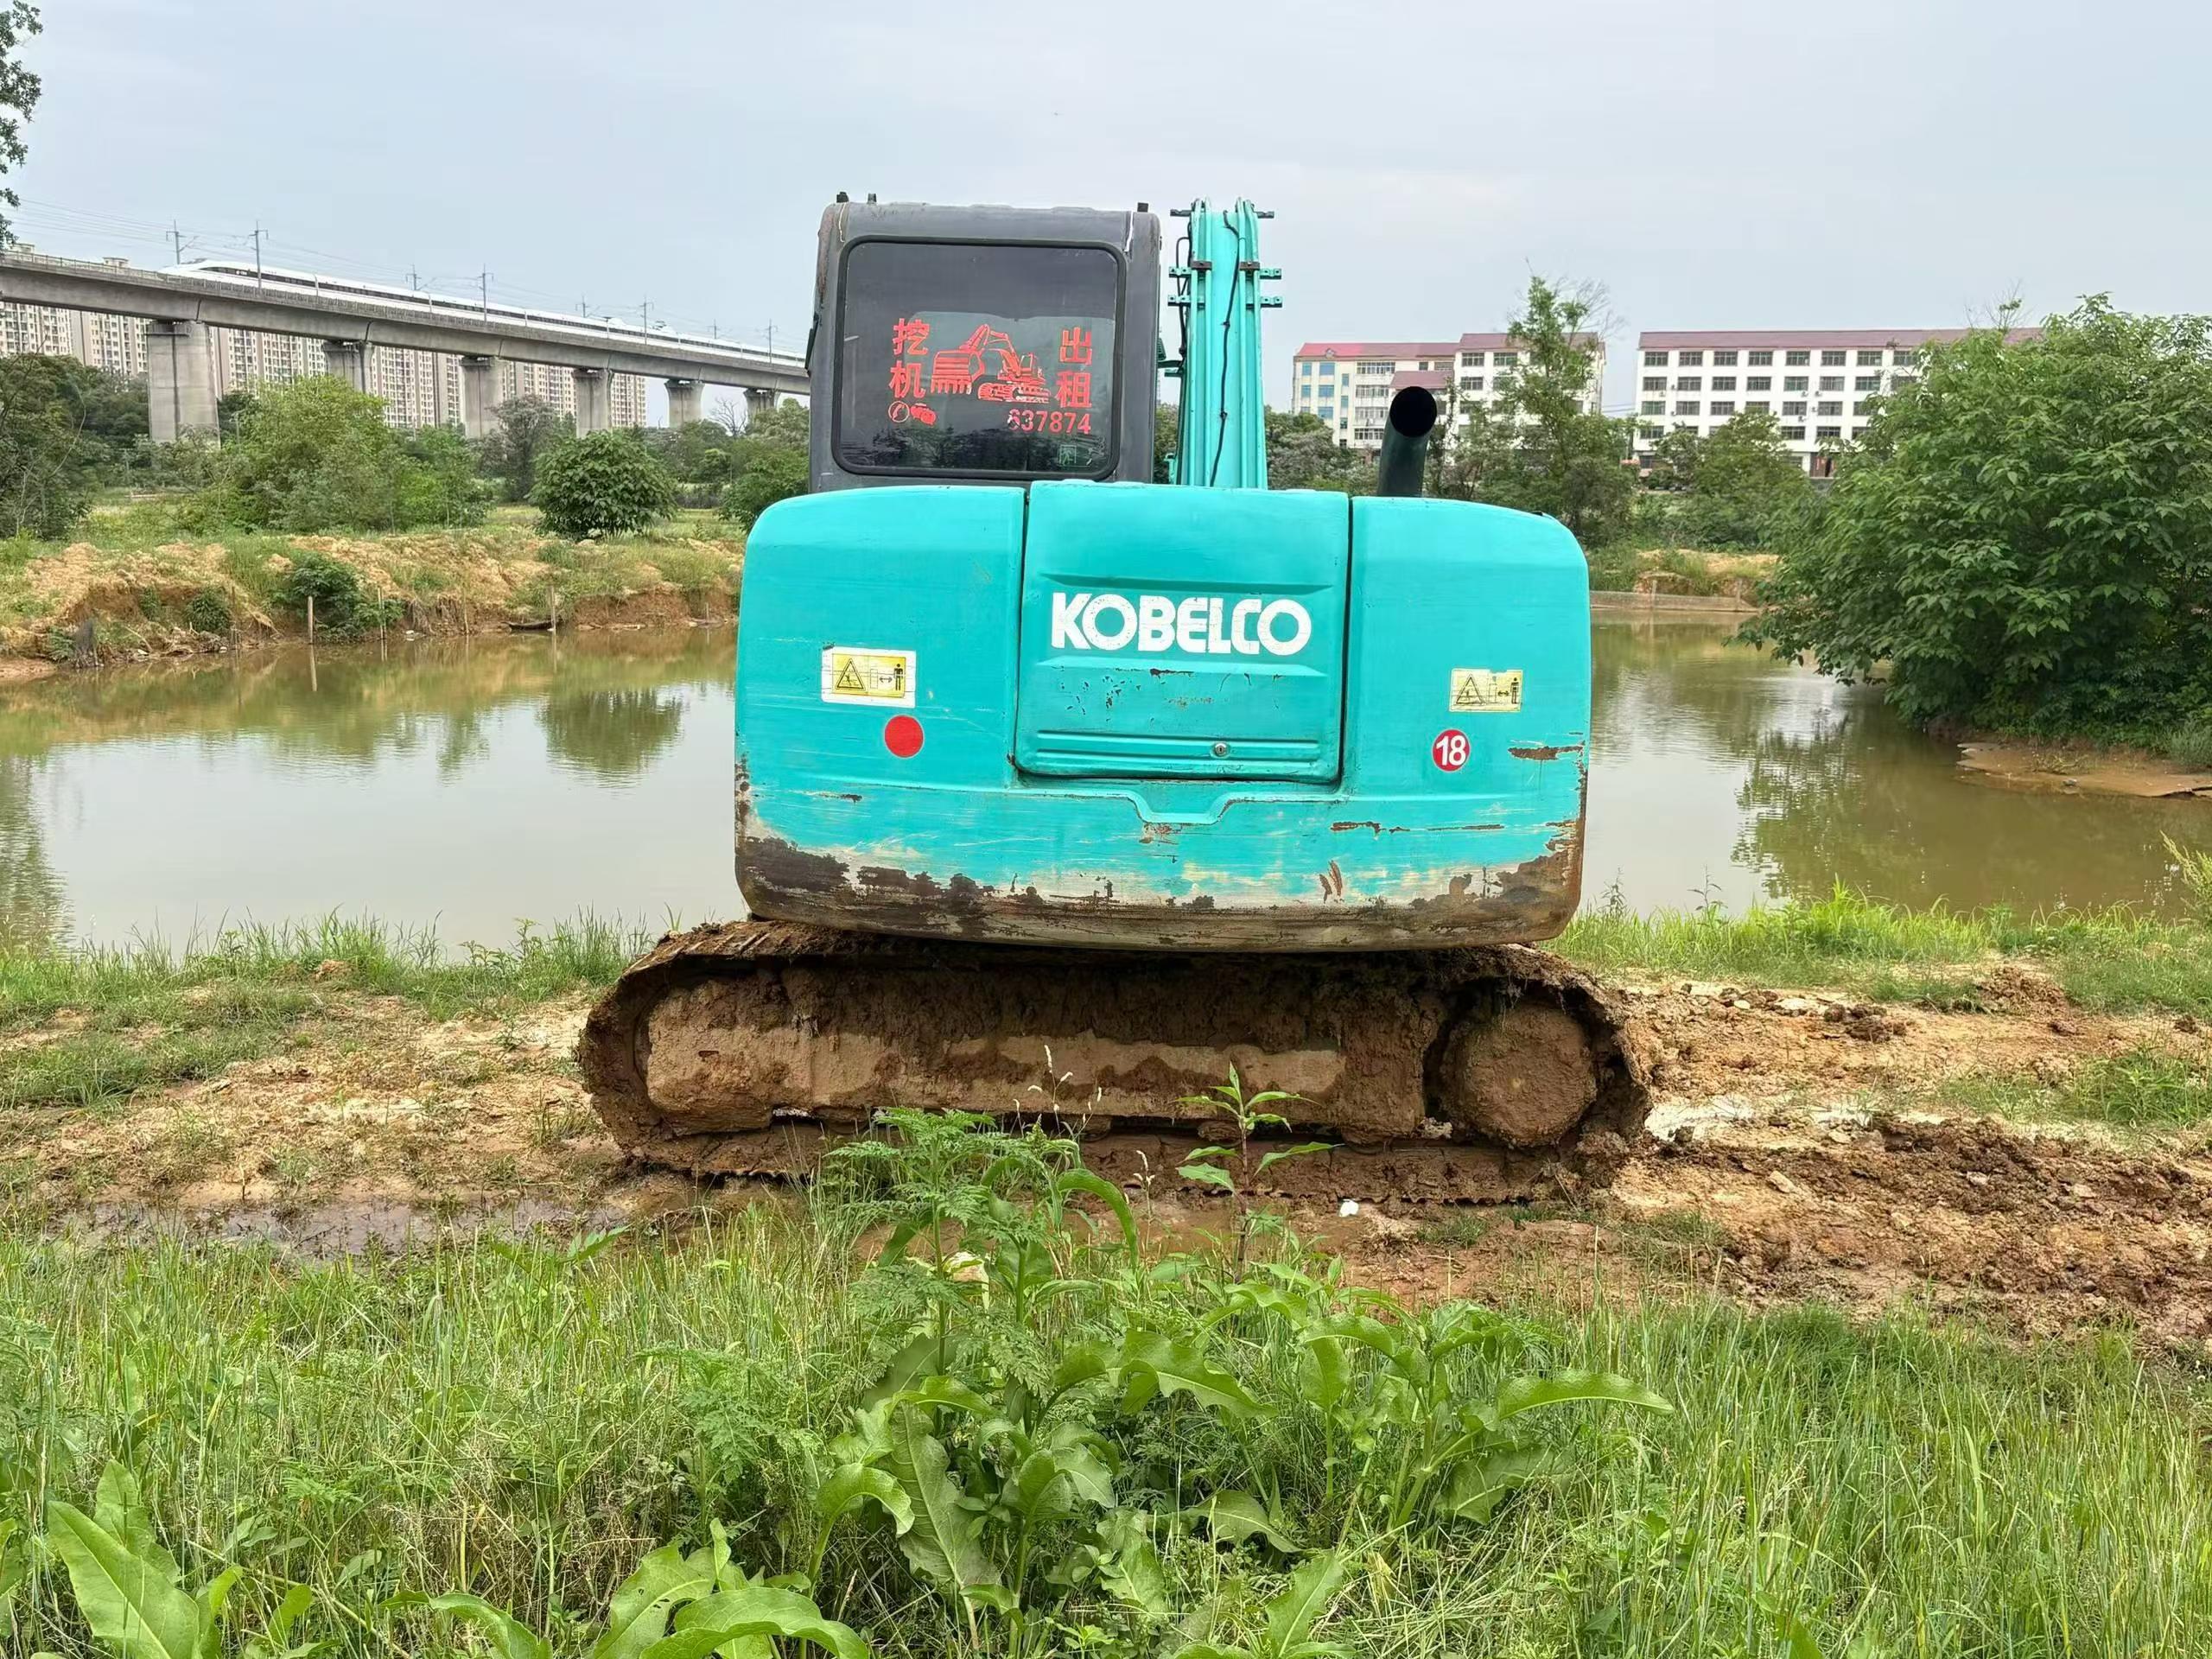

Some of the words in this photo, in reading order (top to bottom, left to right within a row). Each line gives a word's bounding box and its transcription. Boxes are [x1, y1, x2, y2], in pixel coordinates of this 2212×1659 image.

[889, 318, 930, 397] 挖机
[1054, 327, 1092, 408] 出租
[1051, 592, 1312, 656] KOBELCO
[1436, 734, 1466, 766] 18
